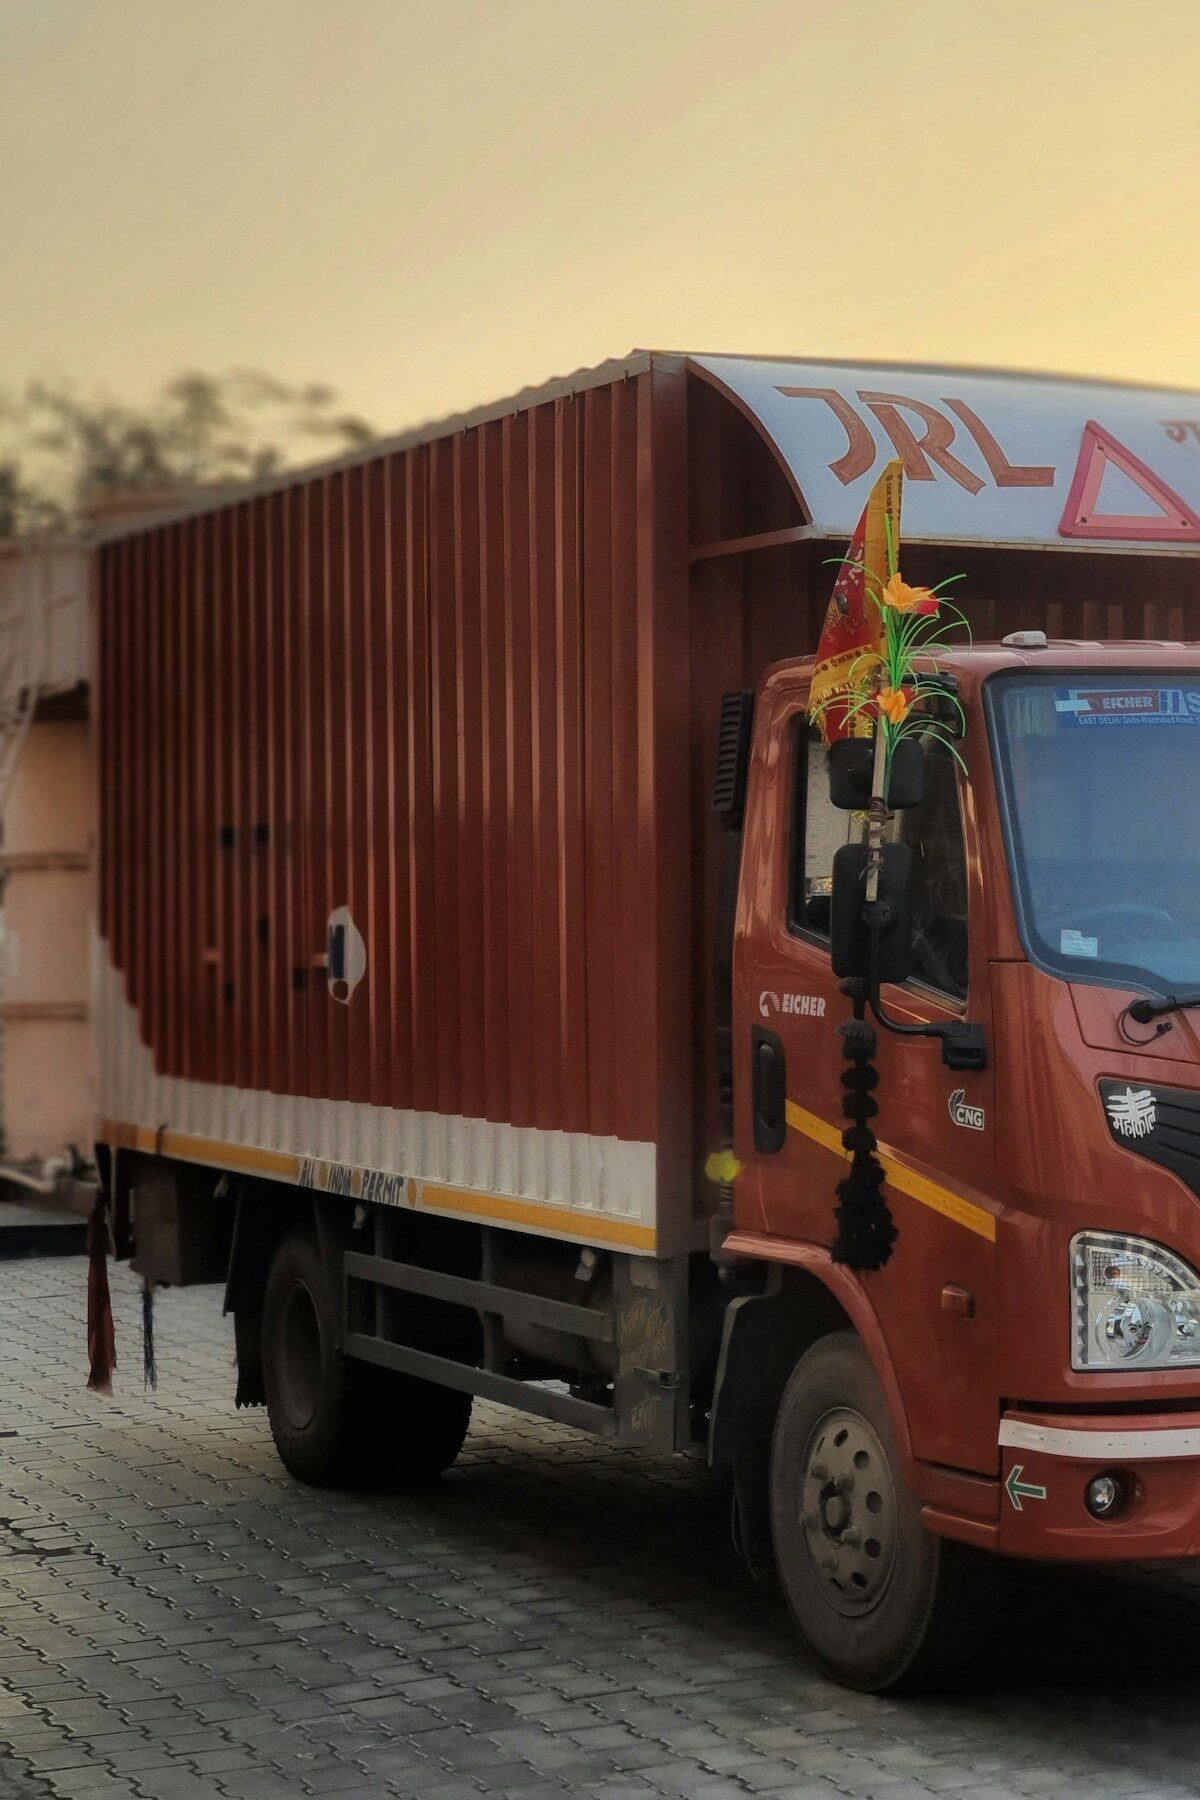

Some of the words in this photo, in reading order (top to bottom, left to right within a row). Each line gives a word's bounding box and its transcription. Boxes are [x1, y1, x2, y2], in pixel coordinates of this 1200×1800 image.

[772, 385, 1057, 497] JRL
[1102, 696, 1154, 709] EICHER
[1078, 716, 1097, 725] EAST
[781, 993, 826, 1018] EICHER
[956, 1107, 984, 1126] CNG
[1107, 1105, 1156, 1139] महाकाल
[299, 1159, 315, 1188] ALL
[360, 1169, 405, 1206] PERMIT
